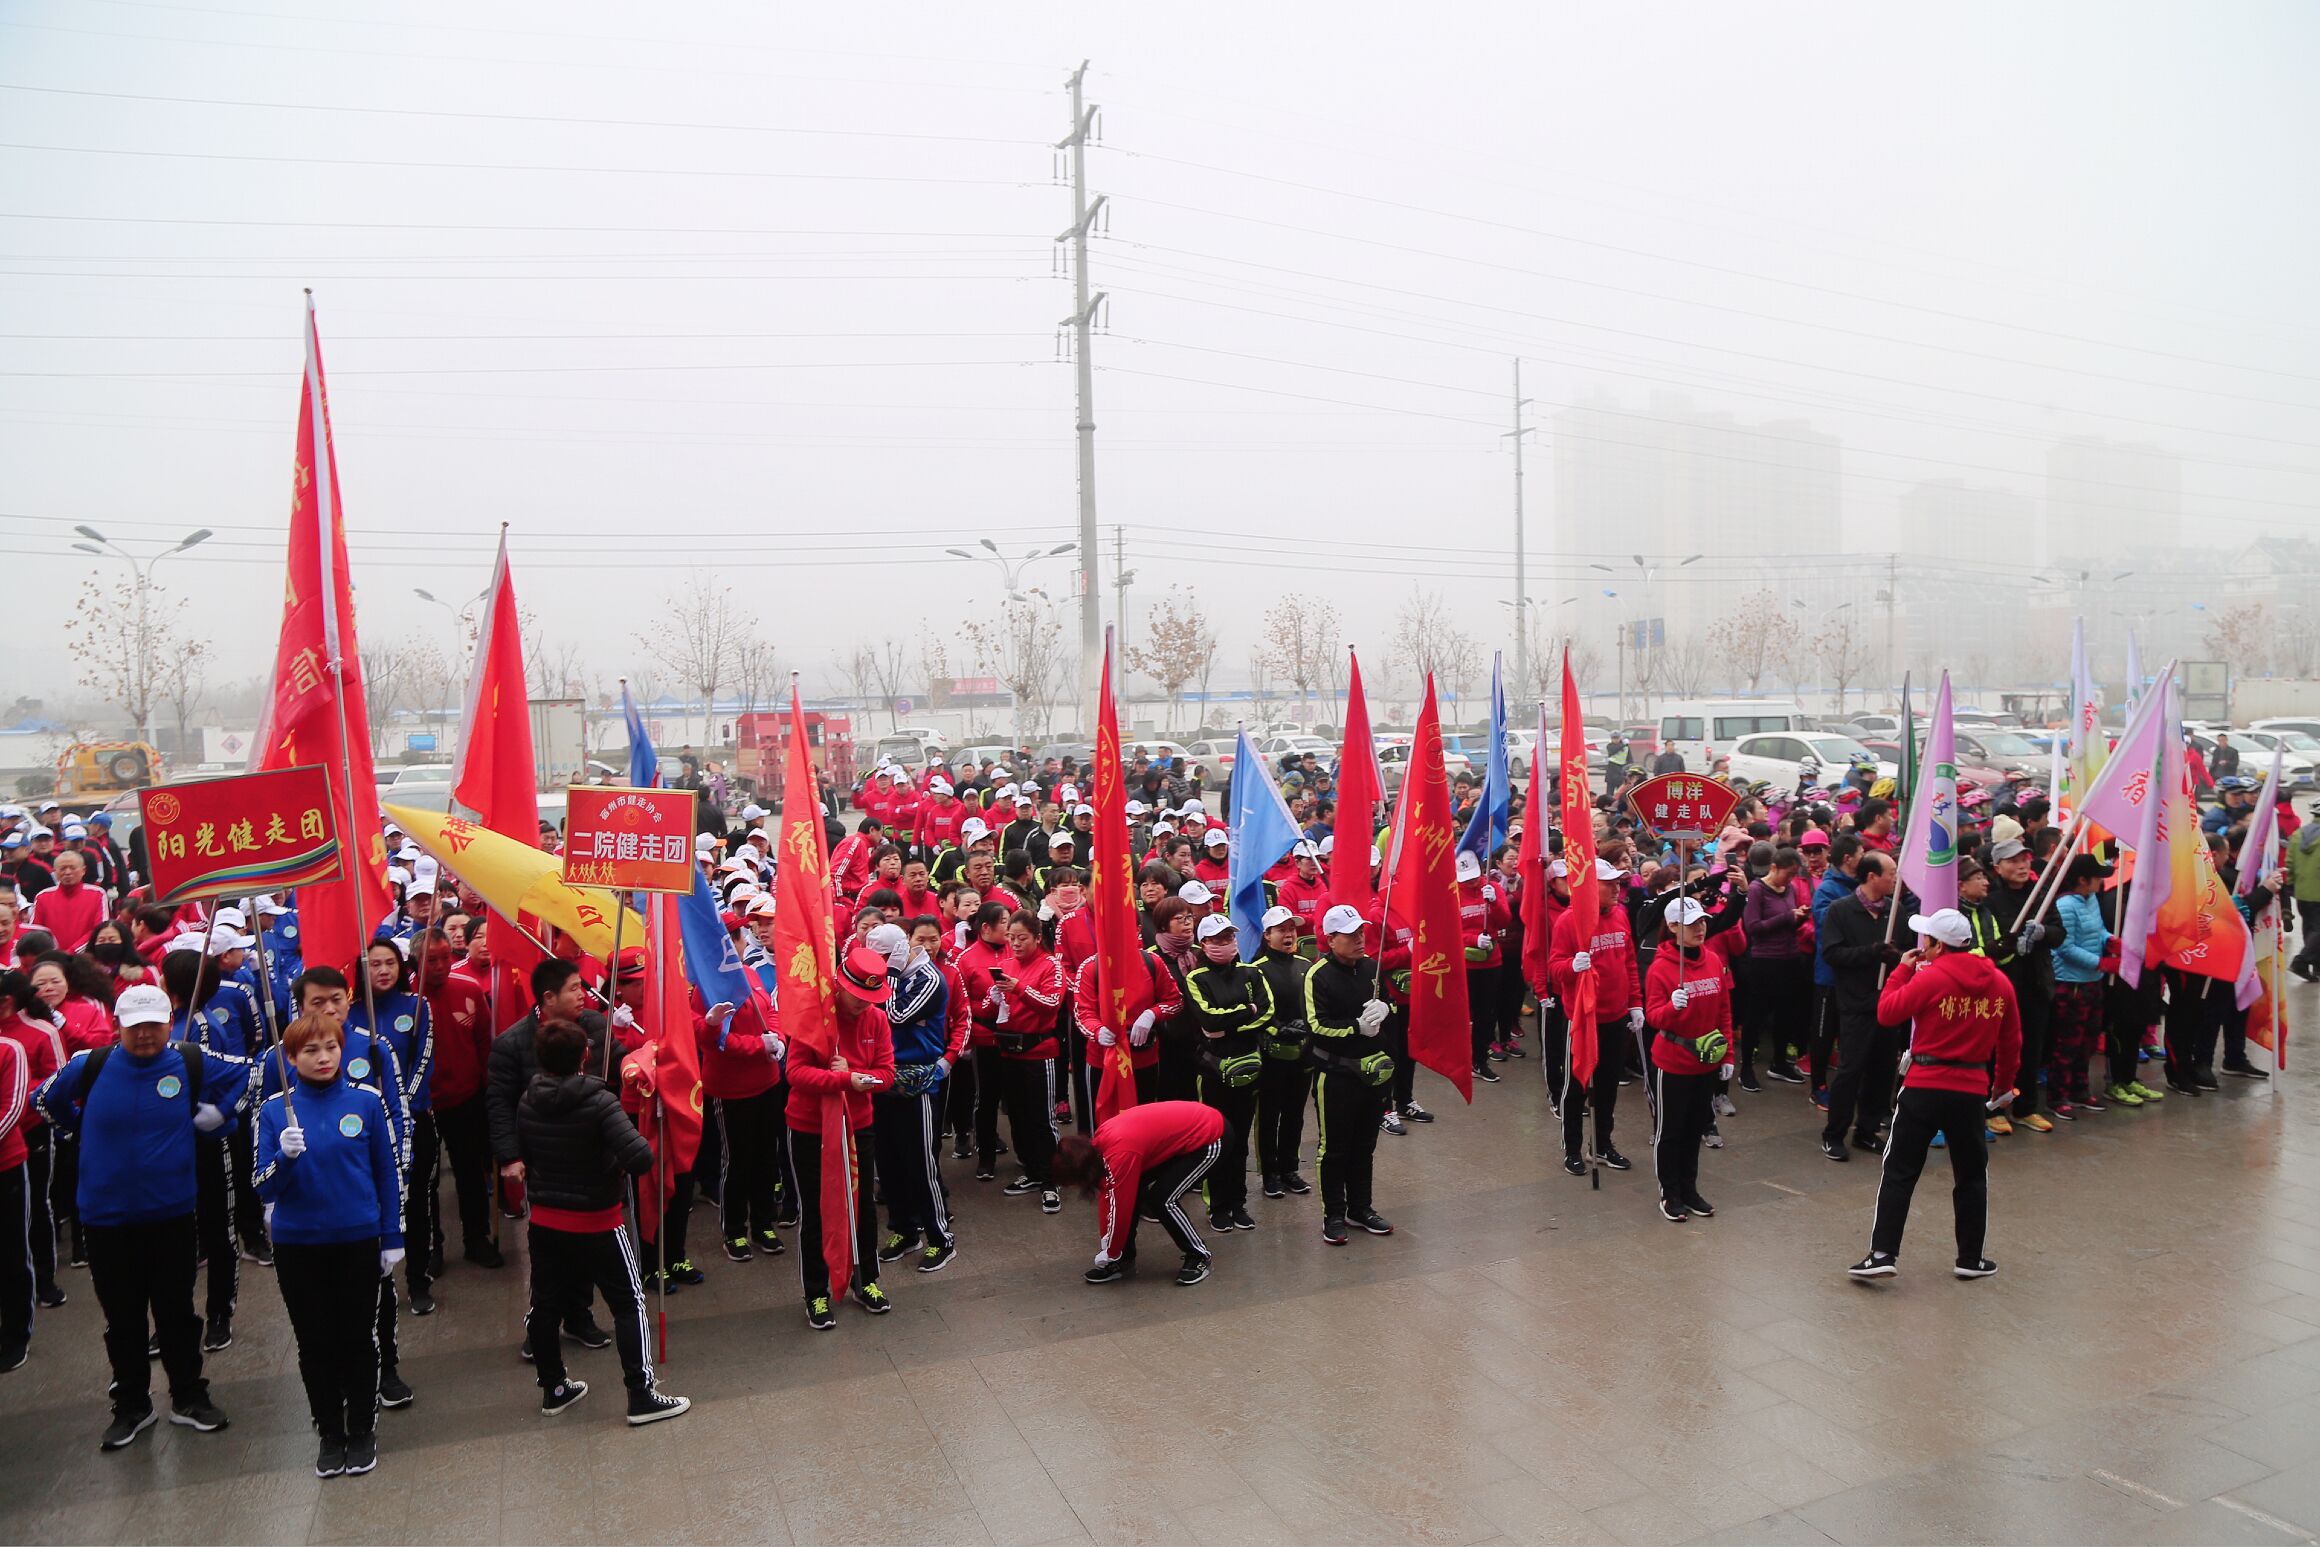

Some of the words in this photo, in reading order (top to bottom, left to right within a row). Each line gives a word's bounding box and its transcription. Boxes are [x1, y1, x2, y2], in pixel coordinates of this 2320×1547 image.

[1666, 780, 1704, 800] 博洋
[599, 795, 662, 823] 宿州市健走协会
[1654, 803, 1713, 819] 健走队
[157, 808, 325, 861] 阳光健走团
[572, 830, 687, 864] 二院健走团
[1938, 995, 2005, 1021] 博洋健走
